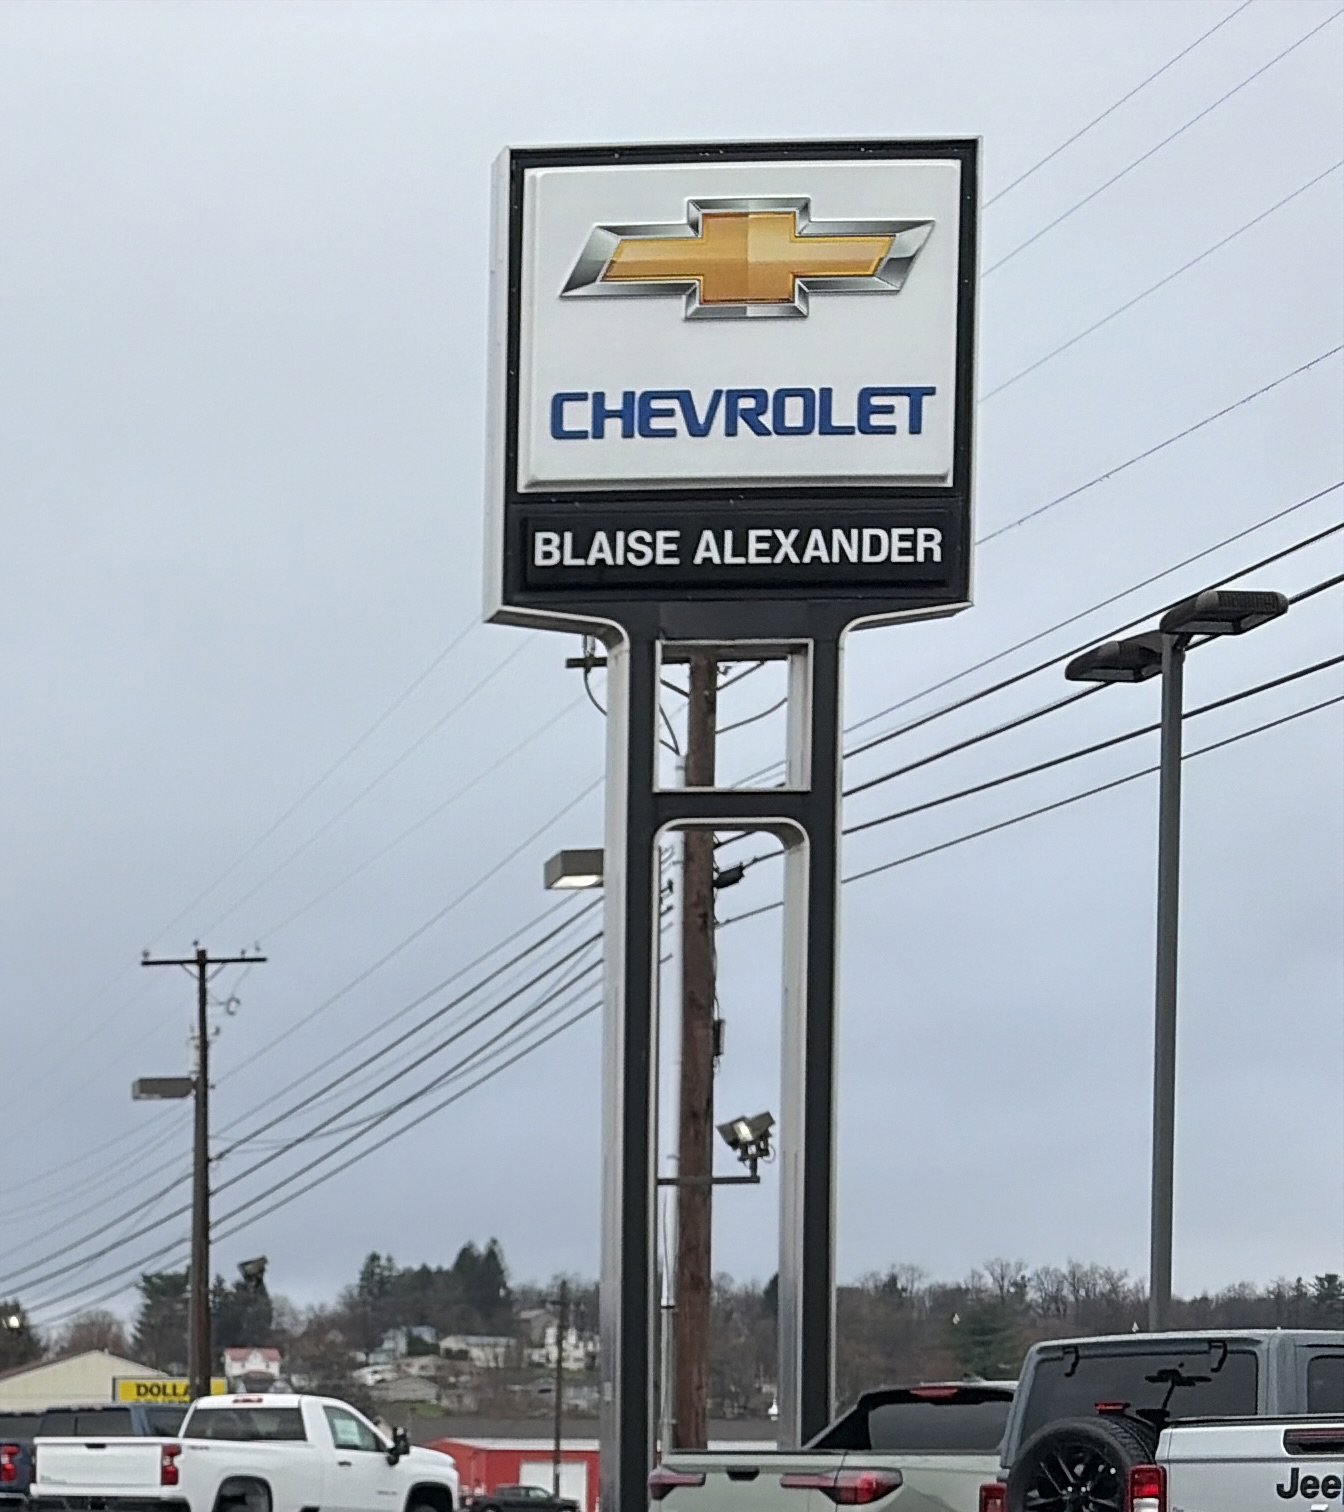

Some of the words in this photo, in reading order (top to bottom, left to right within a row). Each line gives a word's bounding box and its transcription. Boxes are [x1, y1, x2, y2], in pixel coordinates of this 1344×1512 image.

[550, 386, 937, 440] CHEVROLET
[533, 529, 681, 567] BLAISE
[693, 527, 943, 566] ALEXANDER
[1276, 1467, 1344, 1505] Jee
